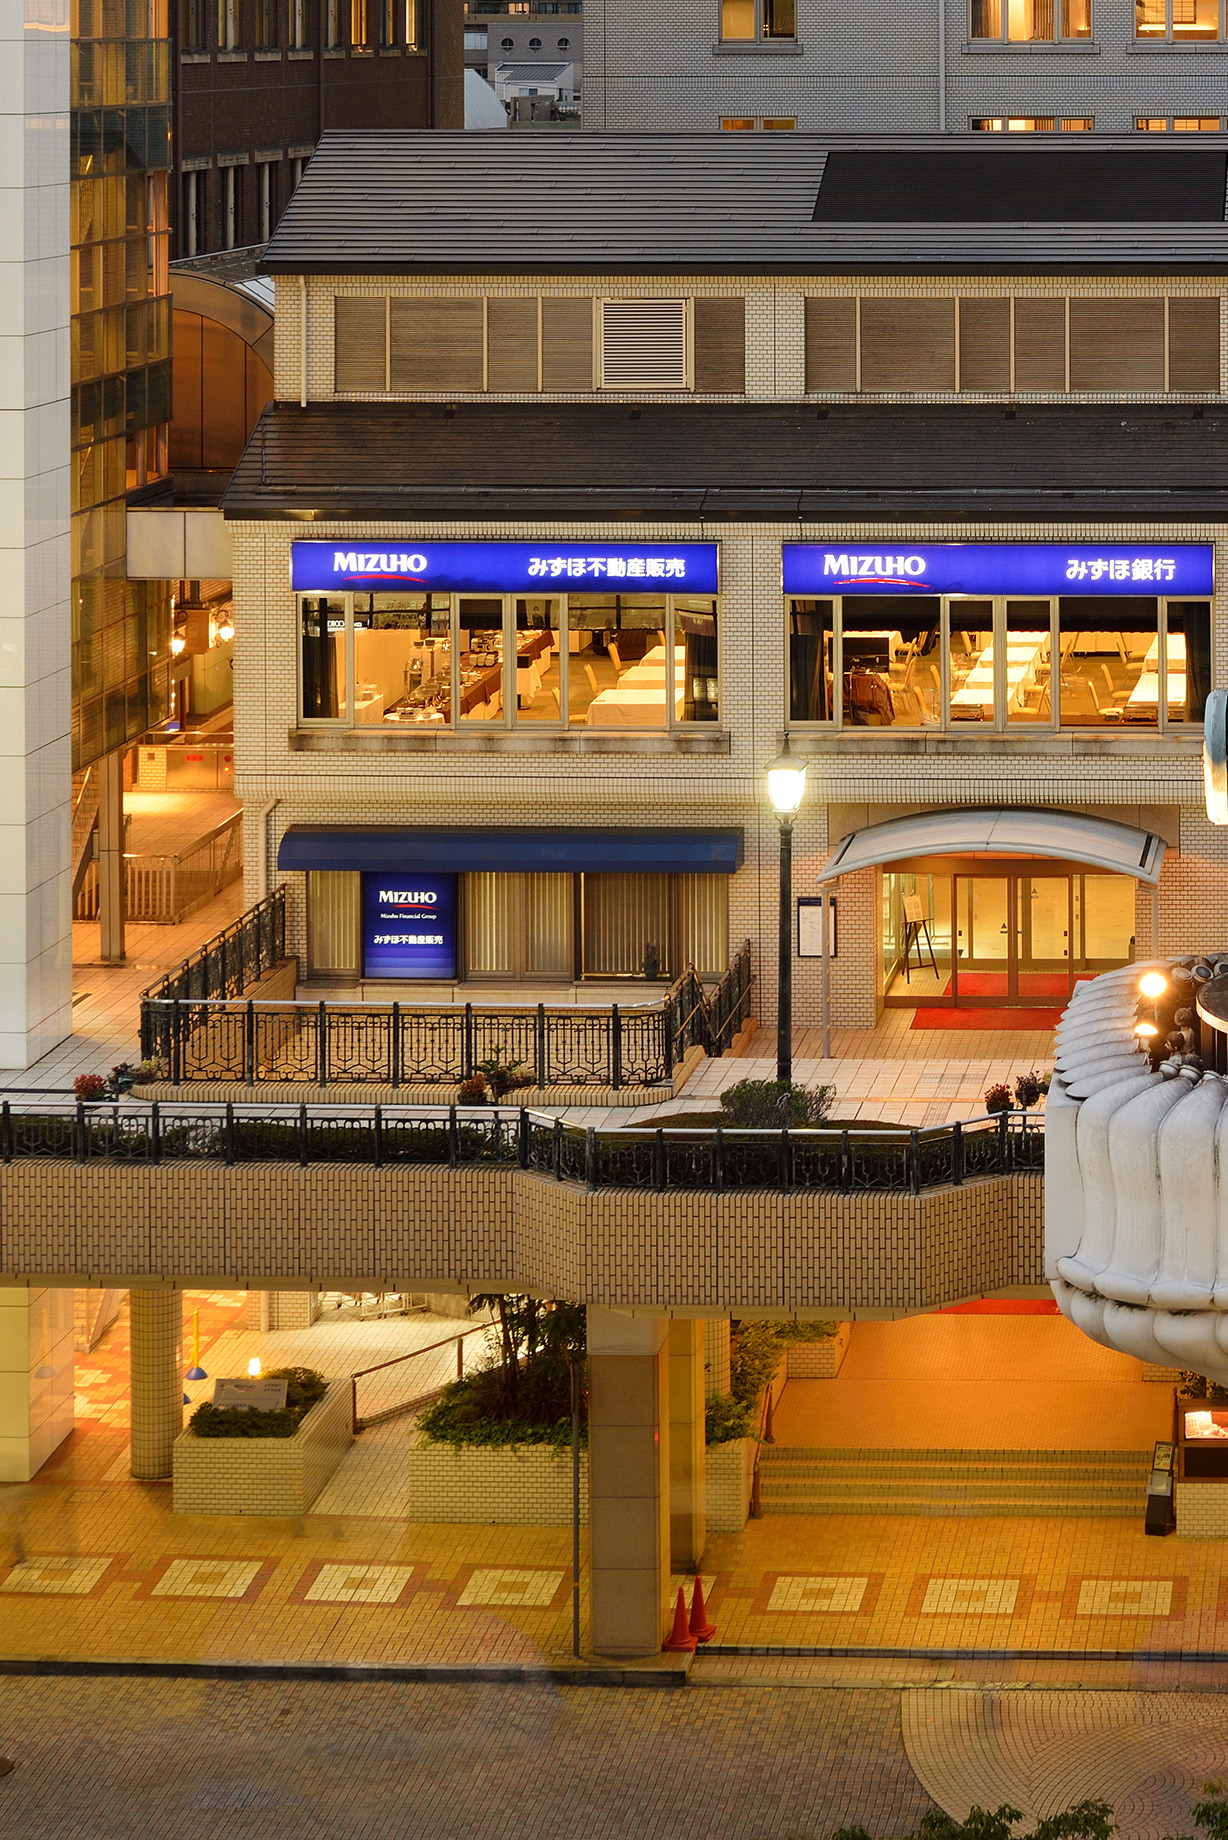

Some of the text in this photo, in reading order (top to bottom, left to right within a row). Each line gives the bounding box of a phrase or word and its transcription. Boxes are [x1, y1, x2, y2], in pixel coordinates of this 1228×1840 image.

[333, 552, 428, 574] MIZUHO
[528, 557, 686, 578] みずほ不動産販売
[823, 554, 927, 576] MIZUHO
[1065, 558, 1177, 581] みずほ銀行
[378, 890, 438, 904] MIZUHO
